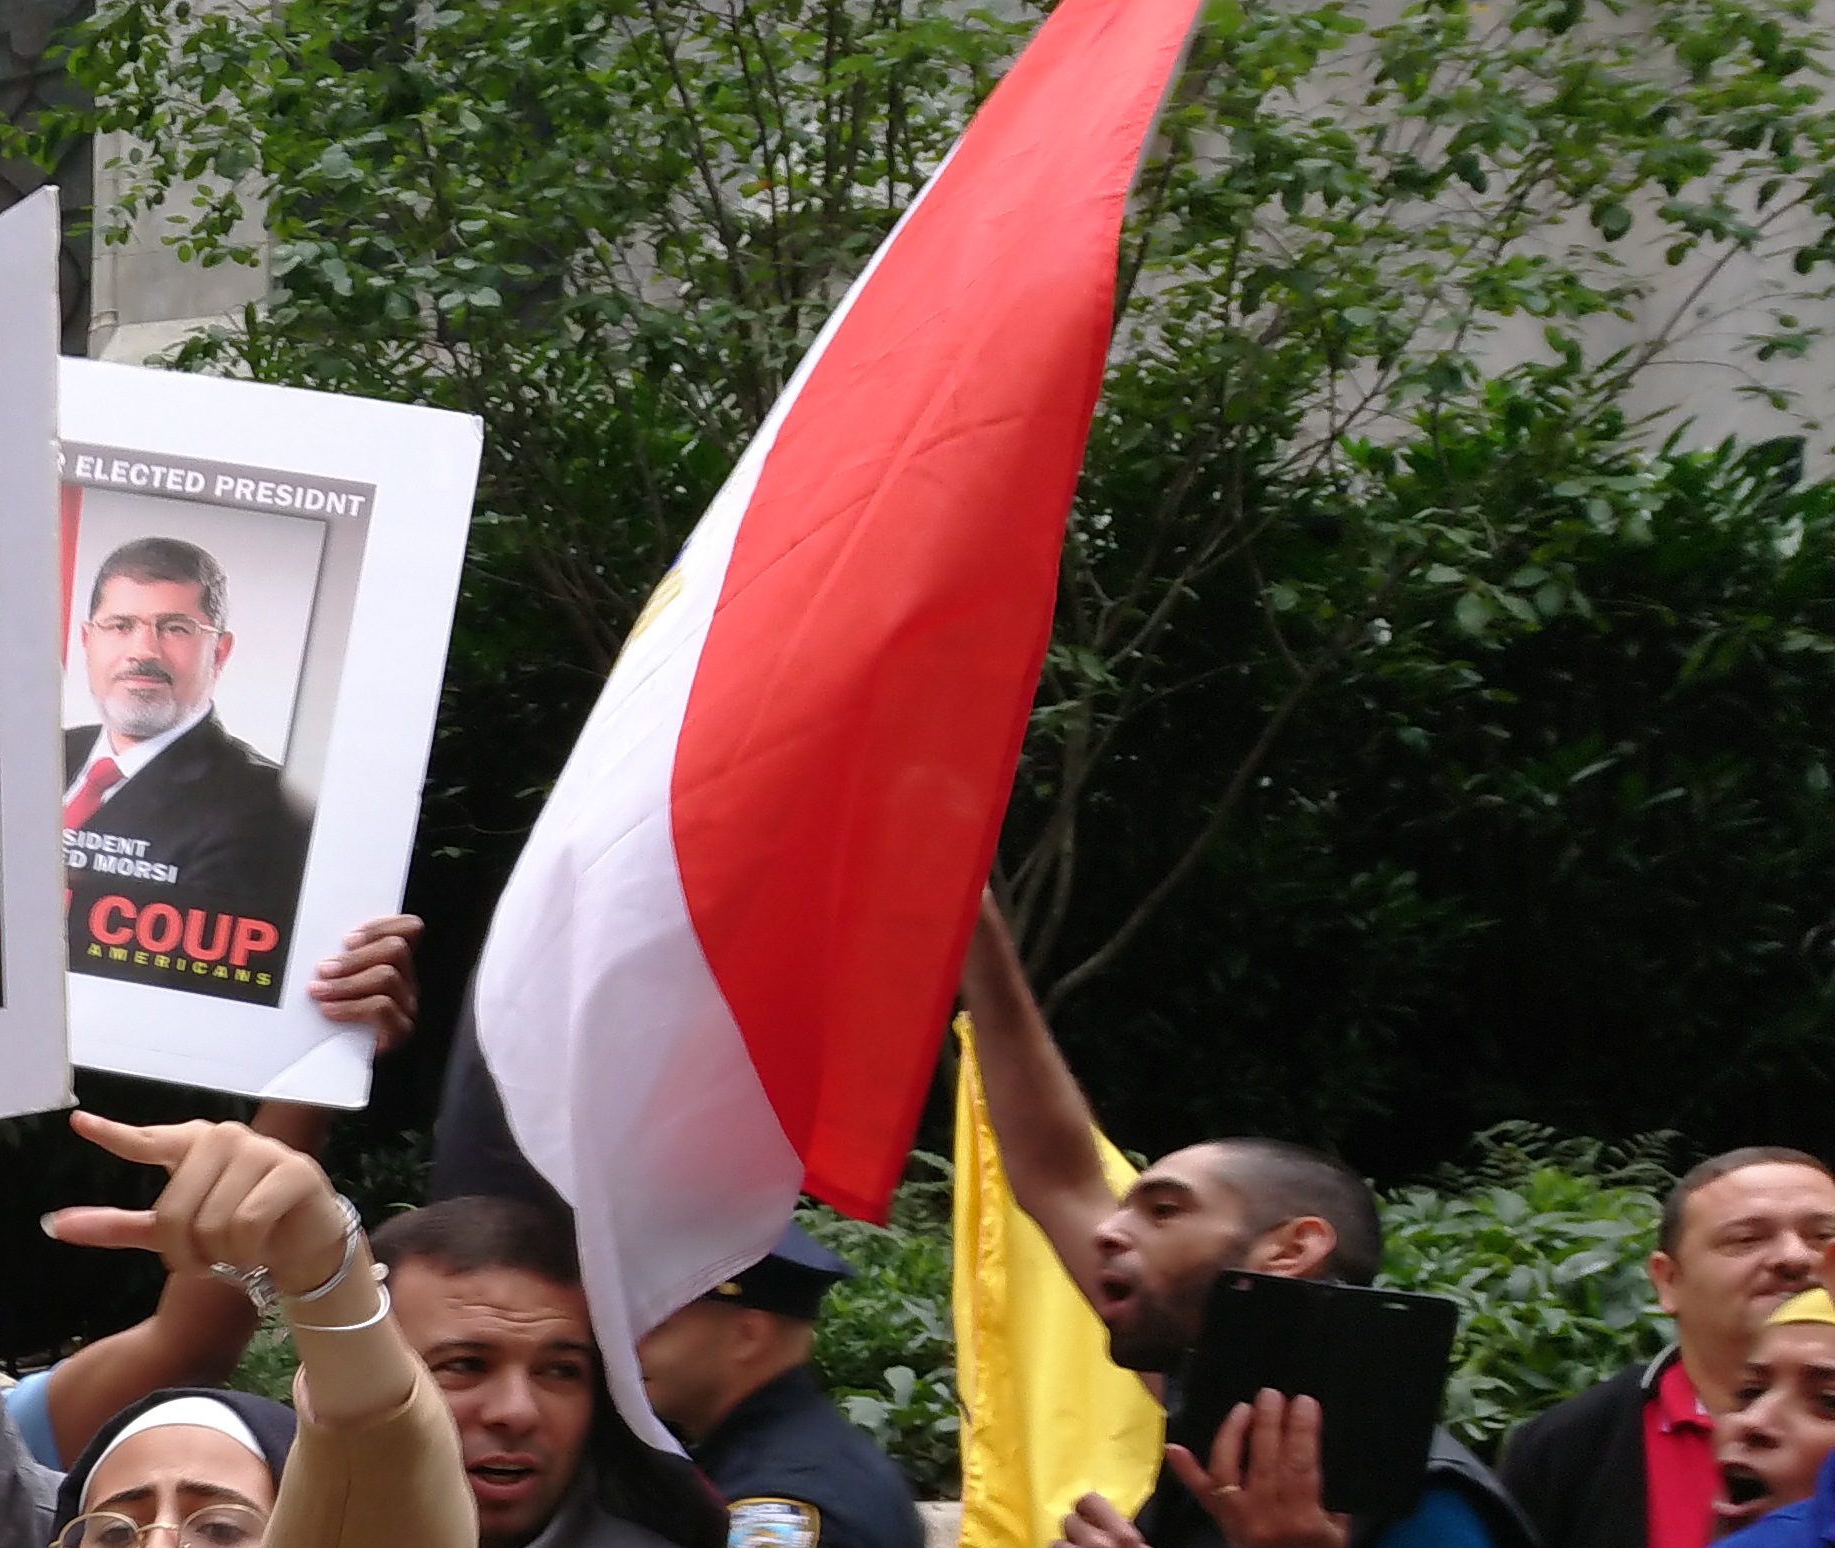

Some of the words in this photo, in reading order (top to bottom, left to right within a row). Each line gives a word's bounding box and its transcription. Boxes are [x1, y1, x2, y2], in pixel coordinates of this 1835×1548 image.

[74, 455, 206, 494] ELECTED
[214, 475, 366, 518] PRESIDNT
[93, 853, 179, 884] MORSI
[88, 895, 280, 966] COUP
[87, 942, 273, 986] AMERICANS
